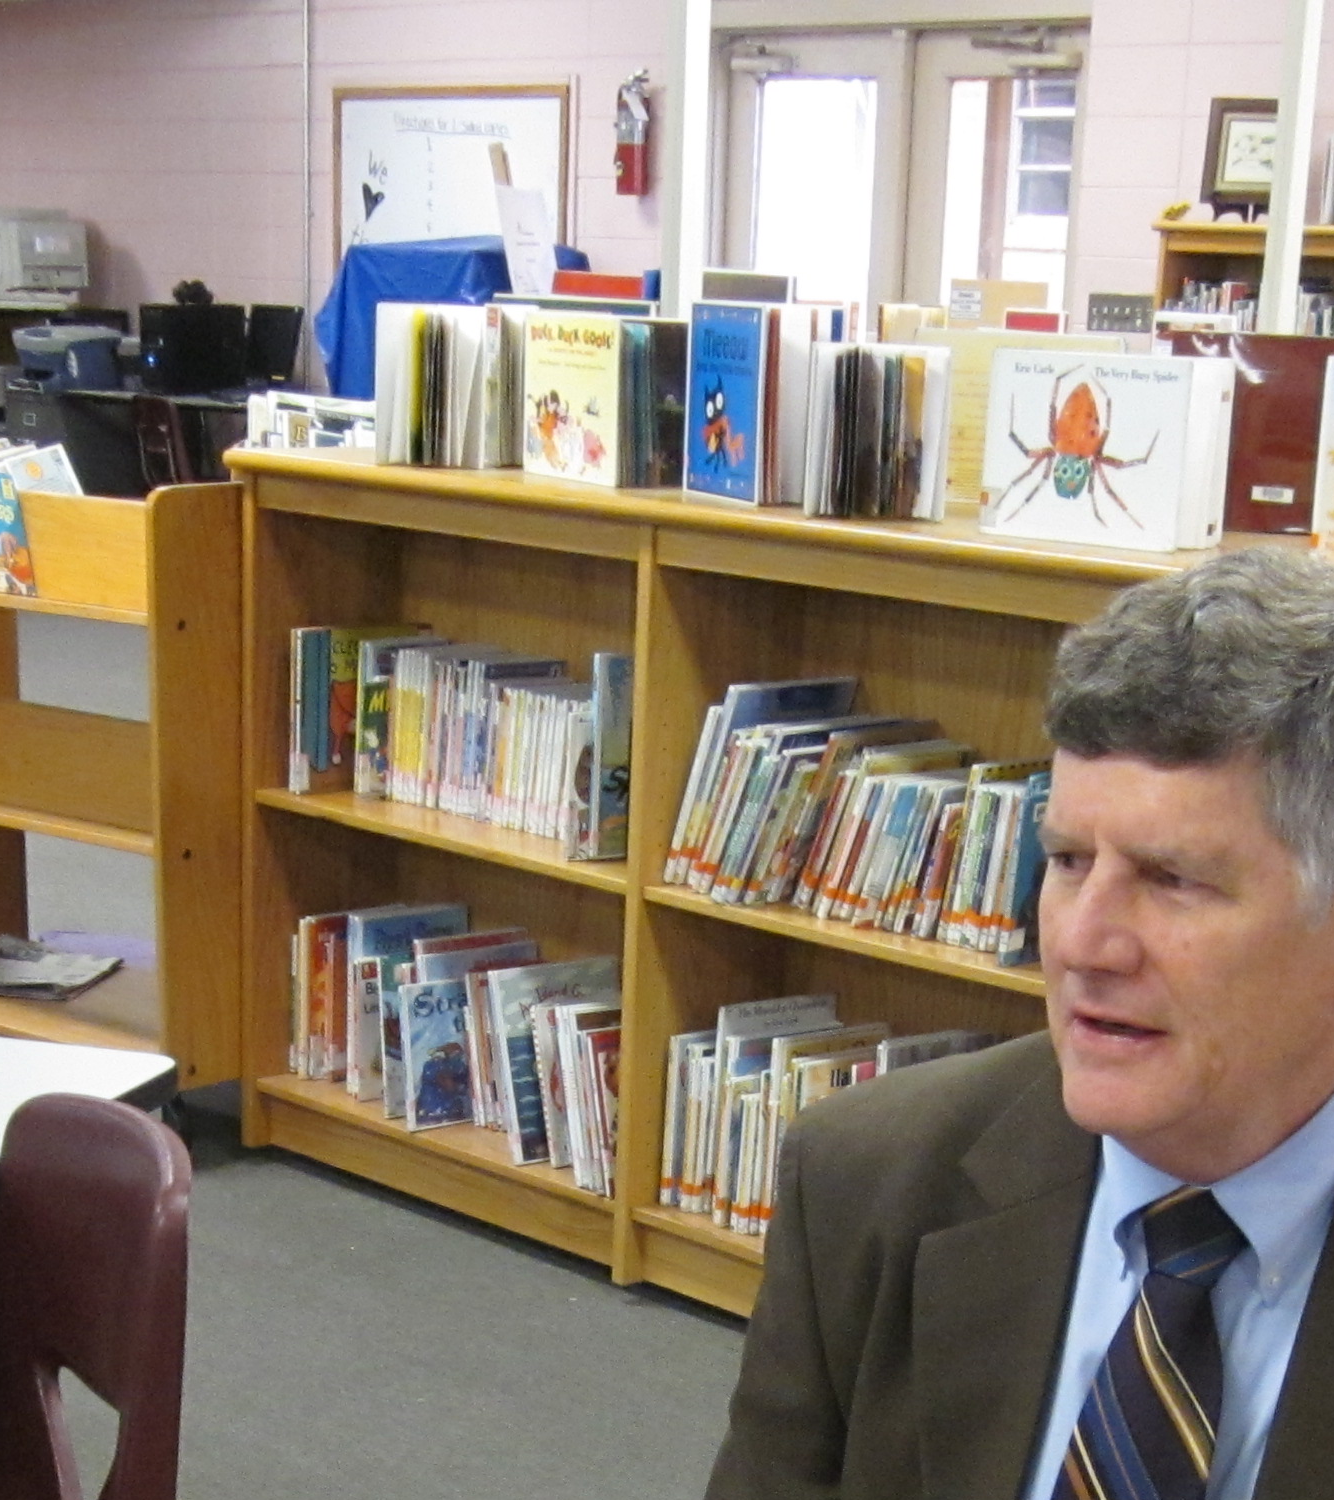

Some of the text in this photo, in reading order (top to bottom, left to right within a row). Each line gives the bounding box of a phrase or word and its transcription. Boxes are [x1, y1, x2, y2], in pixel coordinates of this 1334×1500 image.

[1014, 361, 1055, 374] Eric Carle
[1095, 366, 1109, 377] The
[1110, 367, 1129, 380] Very
[1153, 371, 1179, 382] Spider
